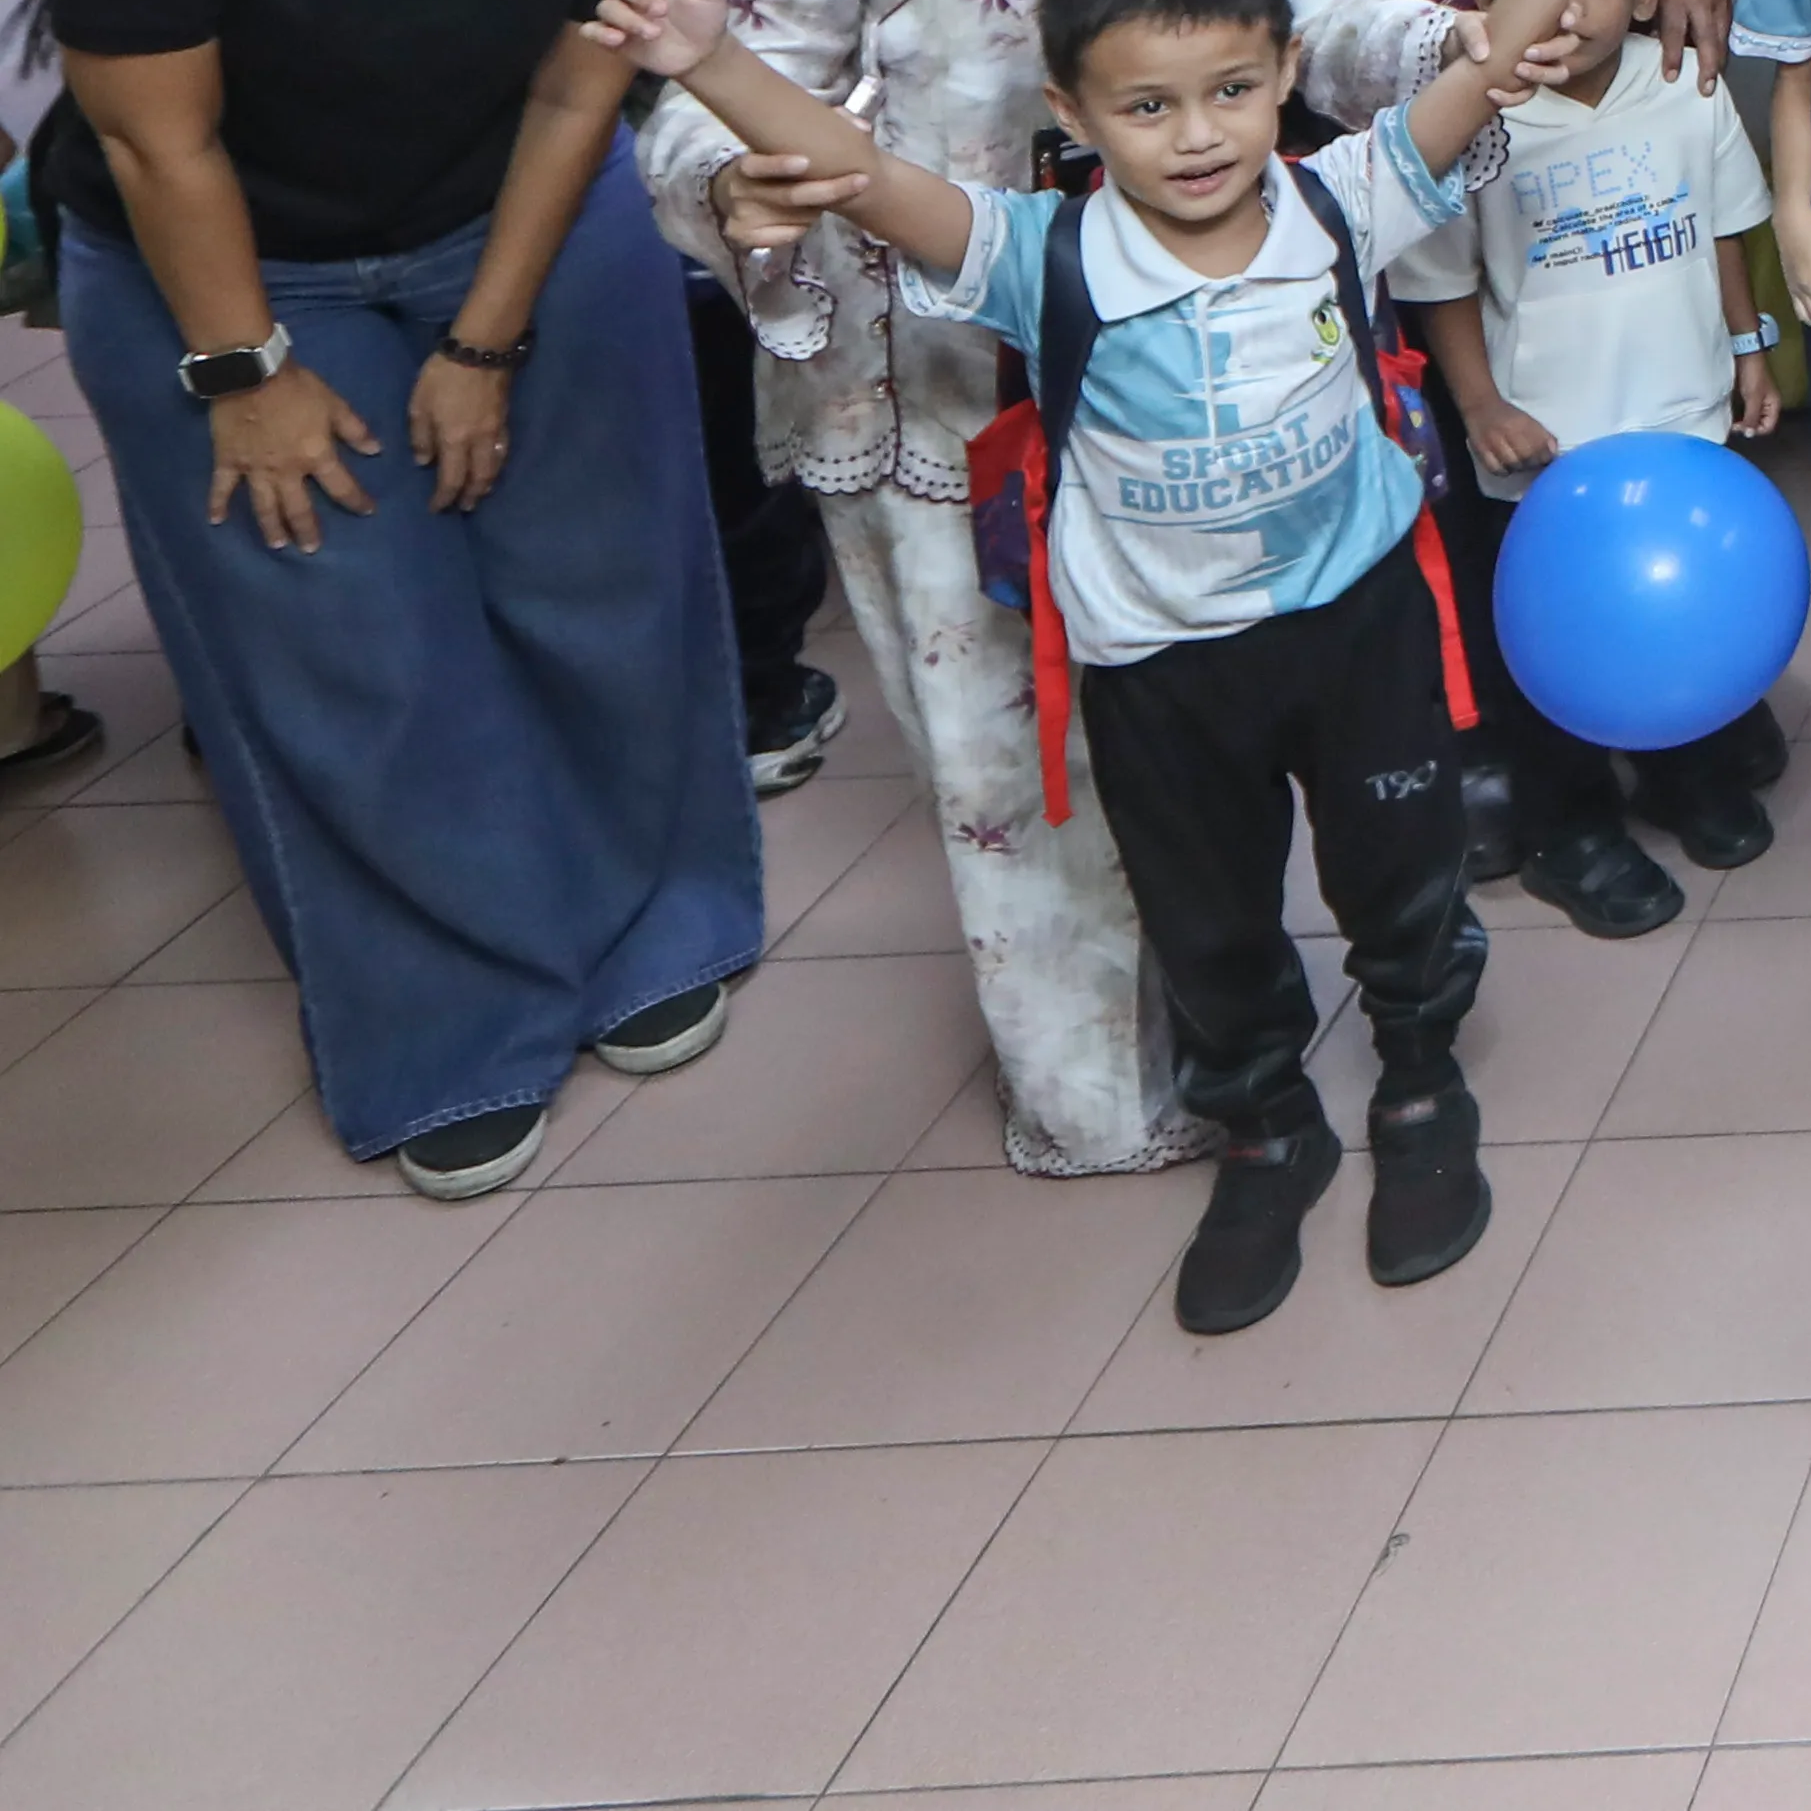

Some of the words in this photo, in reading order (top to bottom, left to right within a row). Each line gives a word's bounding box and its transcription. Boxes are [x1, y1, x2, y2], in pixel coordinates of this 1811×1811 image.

[1510, 141, 1658, 215] APEX
[1602, 213, 1697, 277] HEIGHT
[1118, 414, 1350, 513] EDUCATION
[1162, 412, 1310, 481] SPORT
